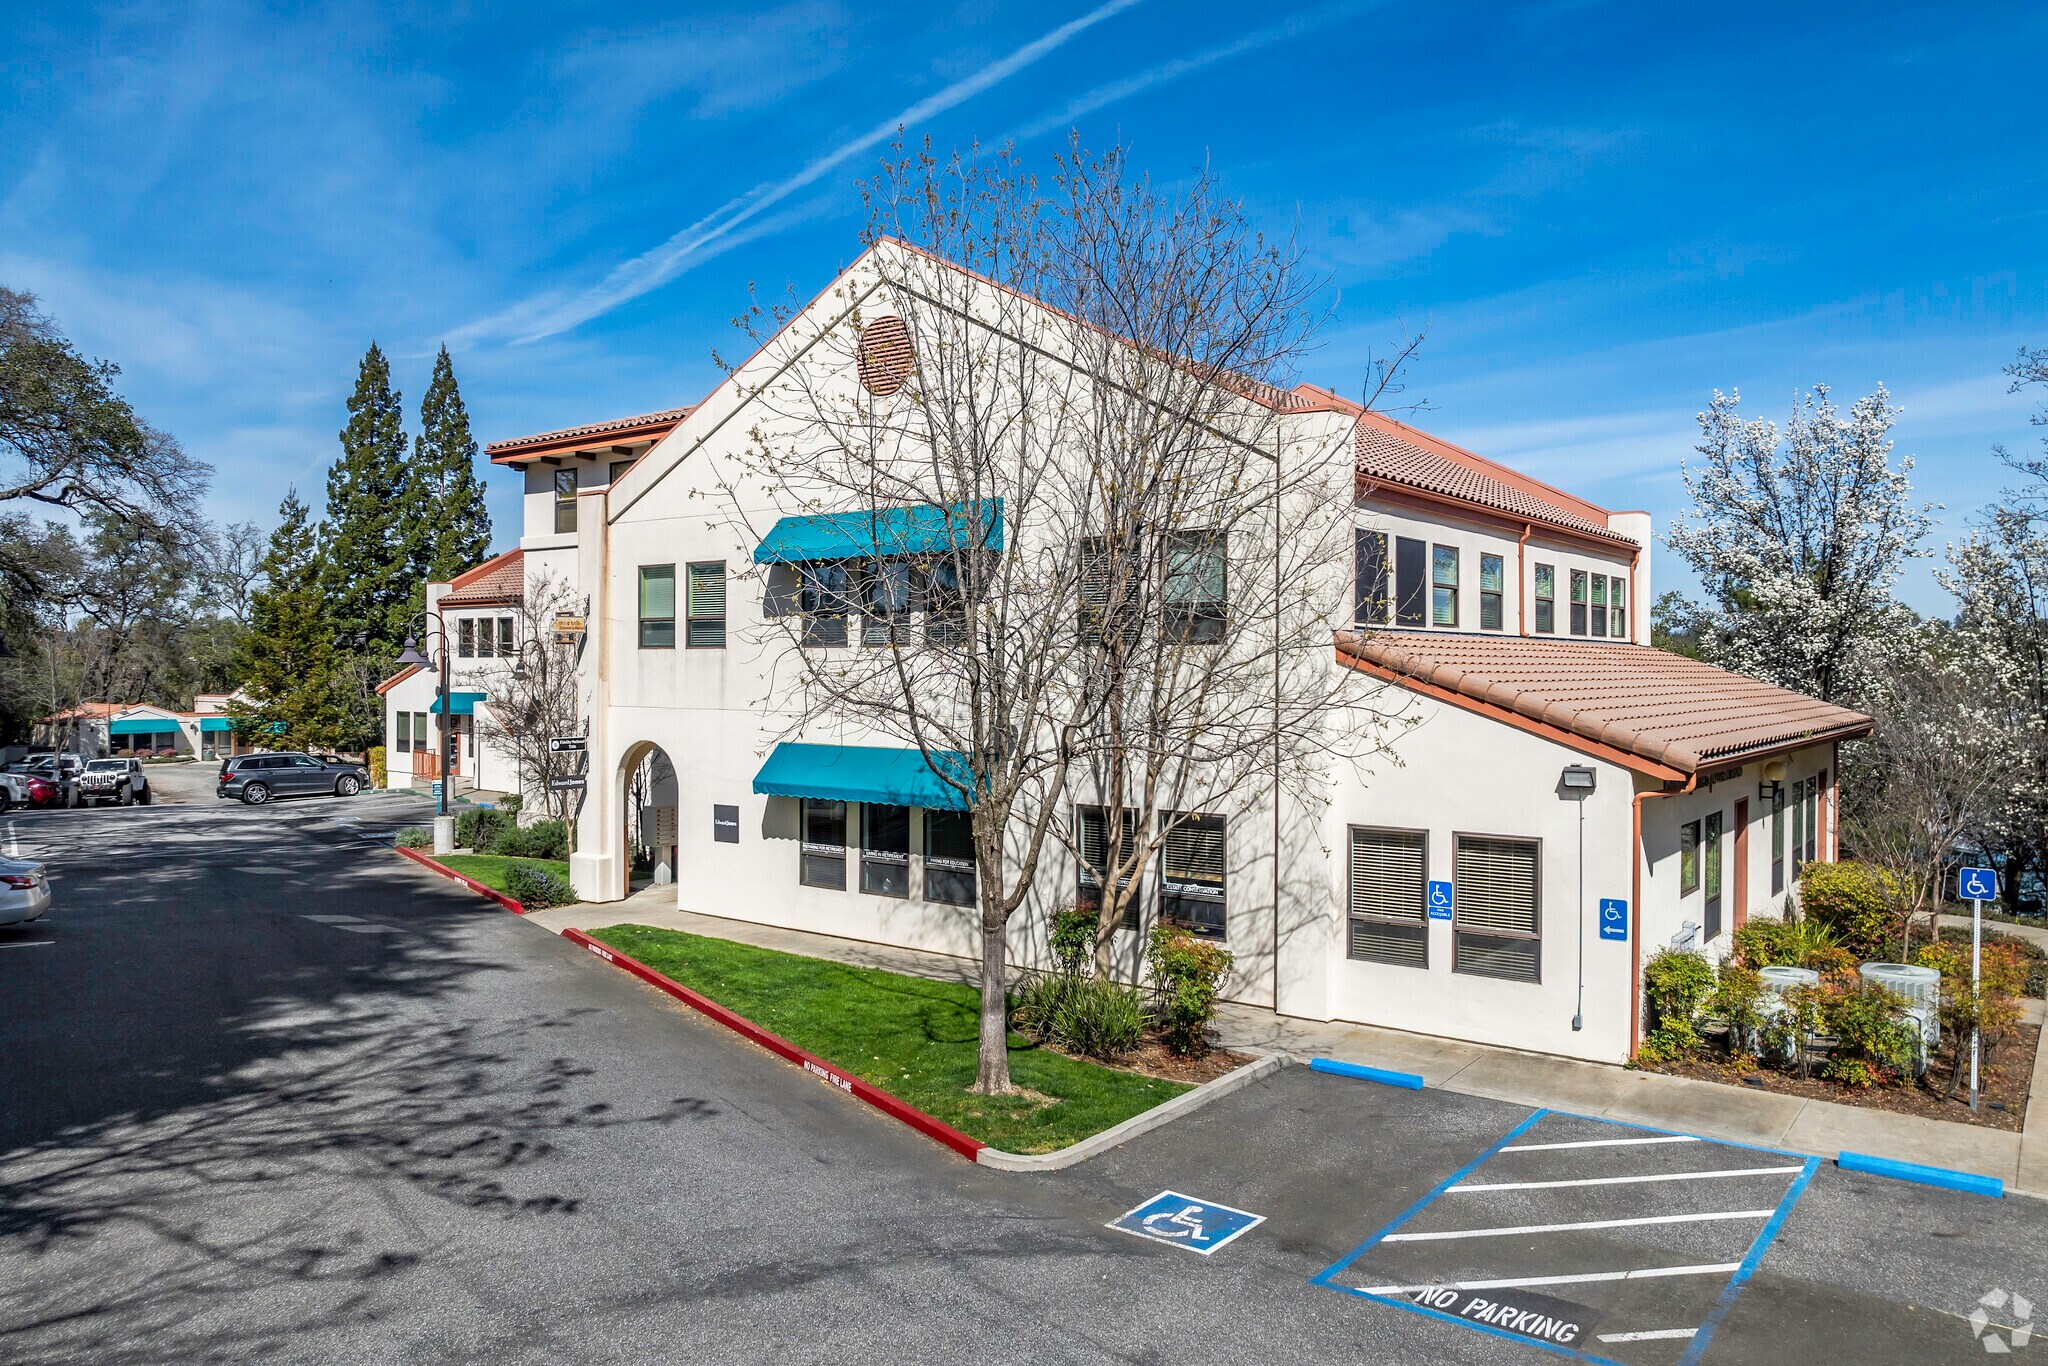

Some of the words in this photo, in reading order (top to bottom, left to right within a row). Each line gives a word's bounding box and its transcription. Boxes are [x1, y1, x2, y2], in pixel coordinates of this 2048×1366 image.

[804, 1060, 811, 1070] NO
[810, 1062, 829, 1080] PARKING
[829, 1072, 840, 1086] FIRE
[840, 1077, 852, 1093] LANE
[1414, 1286, 1459, 1308] NO
[1460, 1297, 1580, 1342] PARKING
